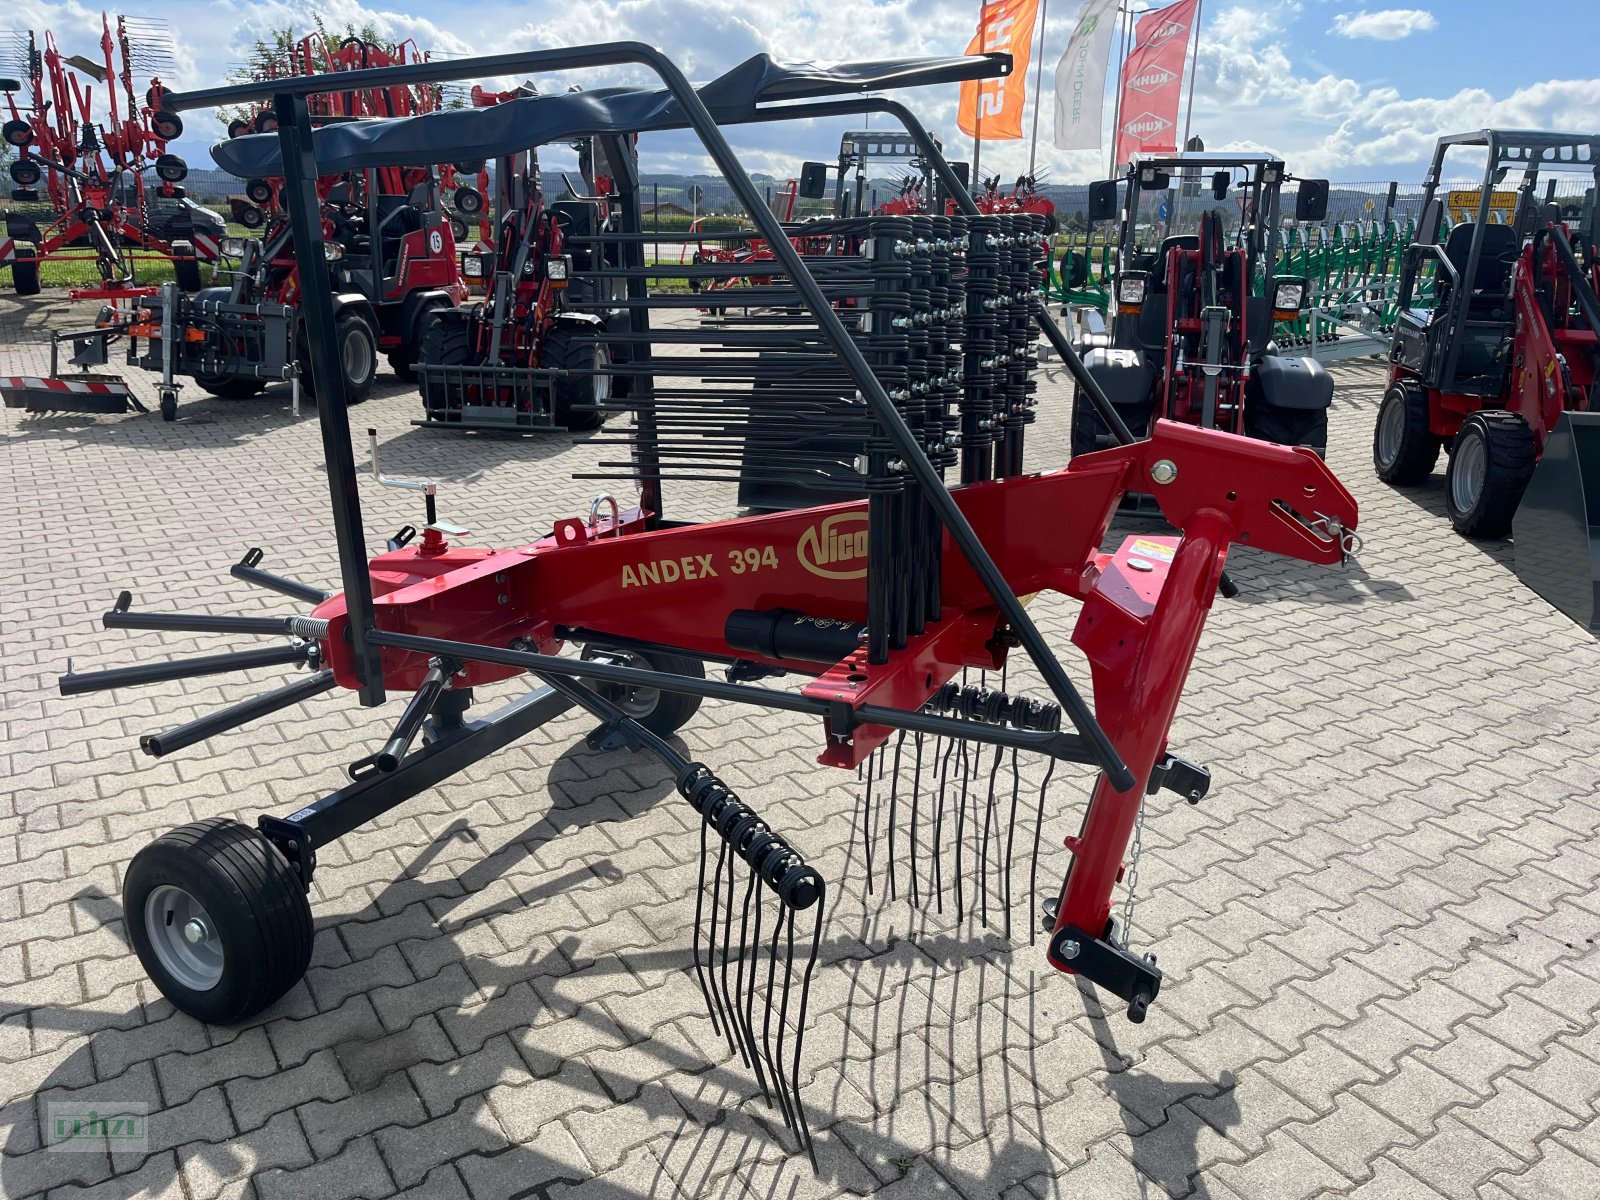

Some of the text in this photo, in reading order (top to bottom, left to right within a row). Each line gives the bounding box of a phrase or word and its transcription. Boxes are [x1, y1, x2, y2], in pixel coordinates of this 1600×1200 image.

[432, 235, 441, 249] 15
[621, 546, 779, 588] ANDEX 394
